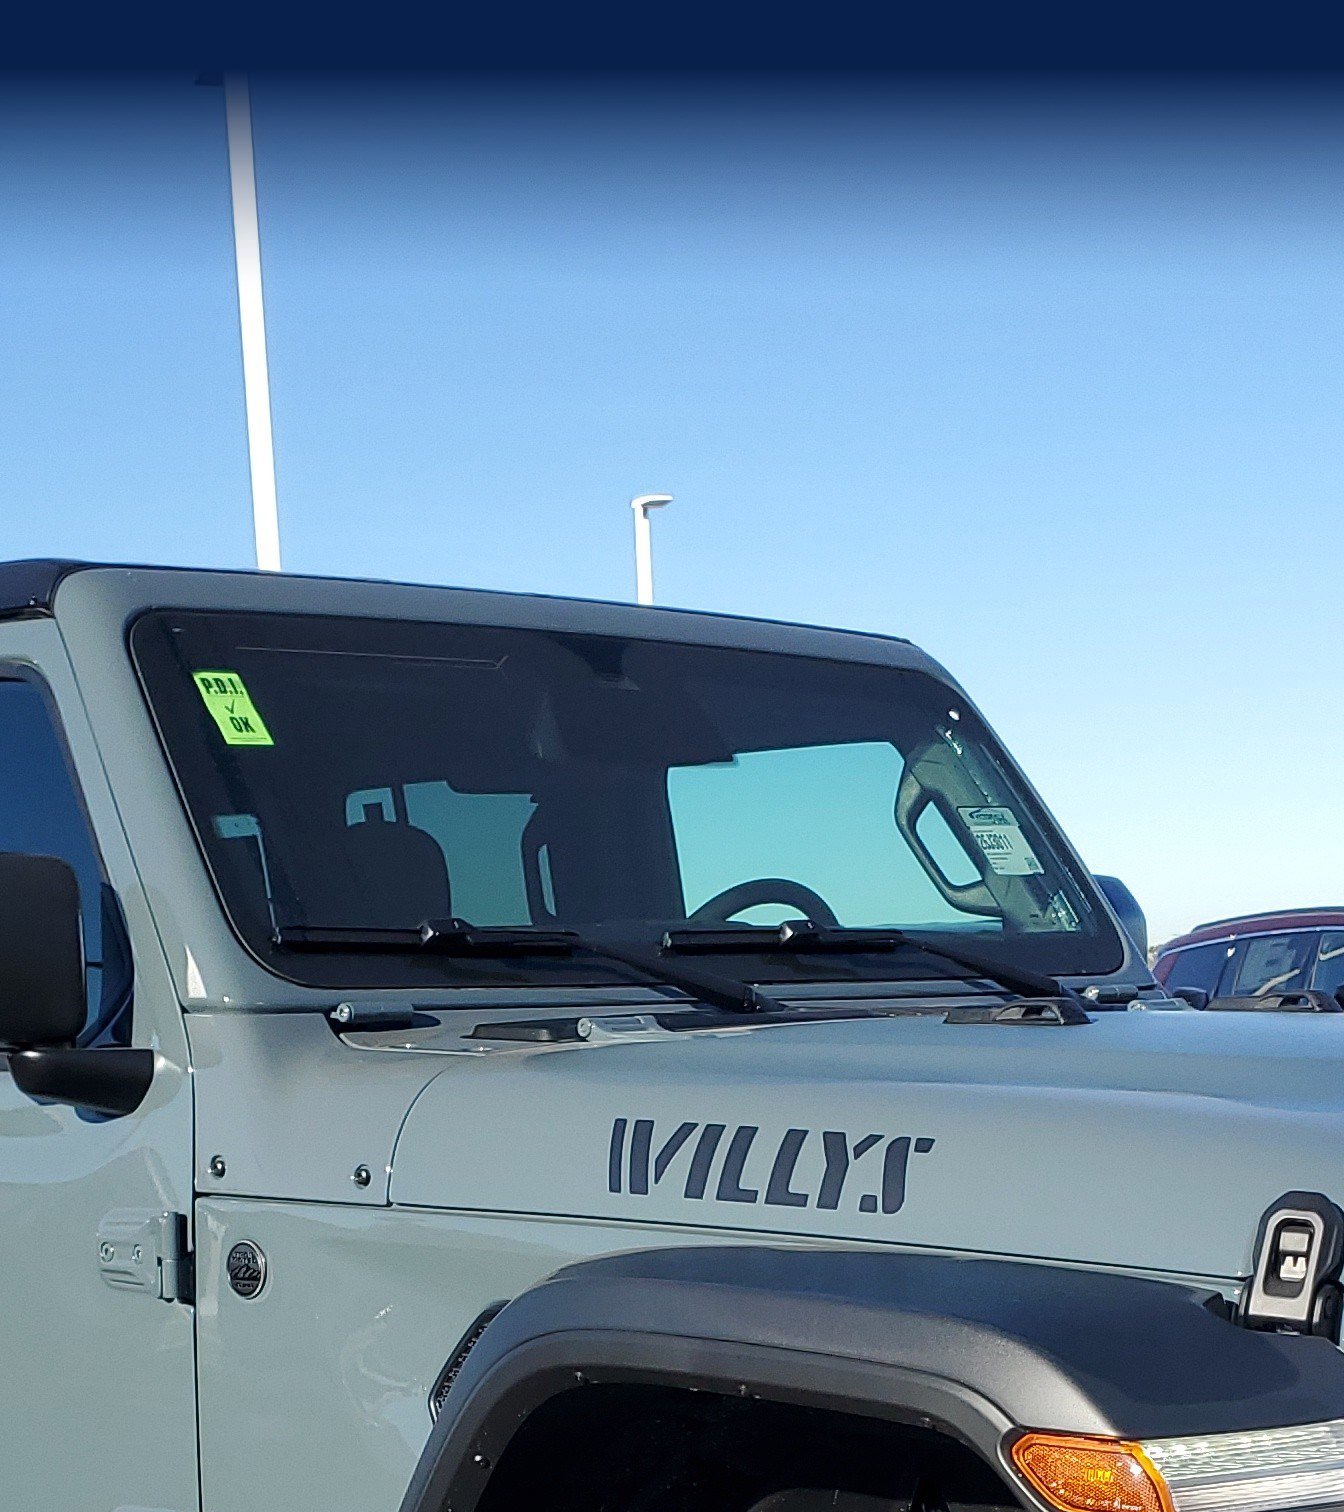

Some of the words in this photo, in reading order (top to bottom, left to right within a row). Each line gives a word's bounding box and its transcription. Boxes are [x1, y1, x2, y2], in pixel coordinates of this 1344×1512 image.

[198, 677, 244, 695] P.D.I.
[228, 716, 256, 733] OK
[608, 1117, 936, 1215] WILLYS
